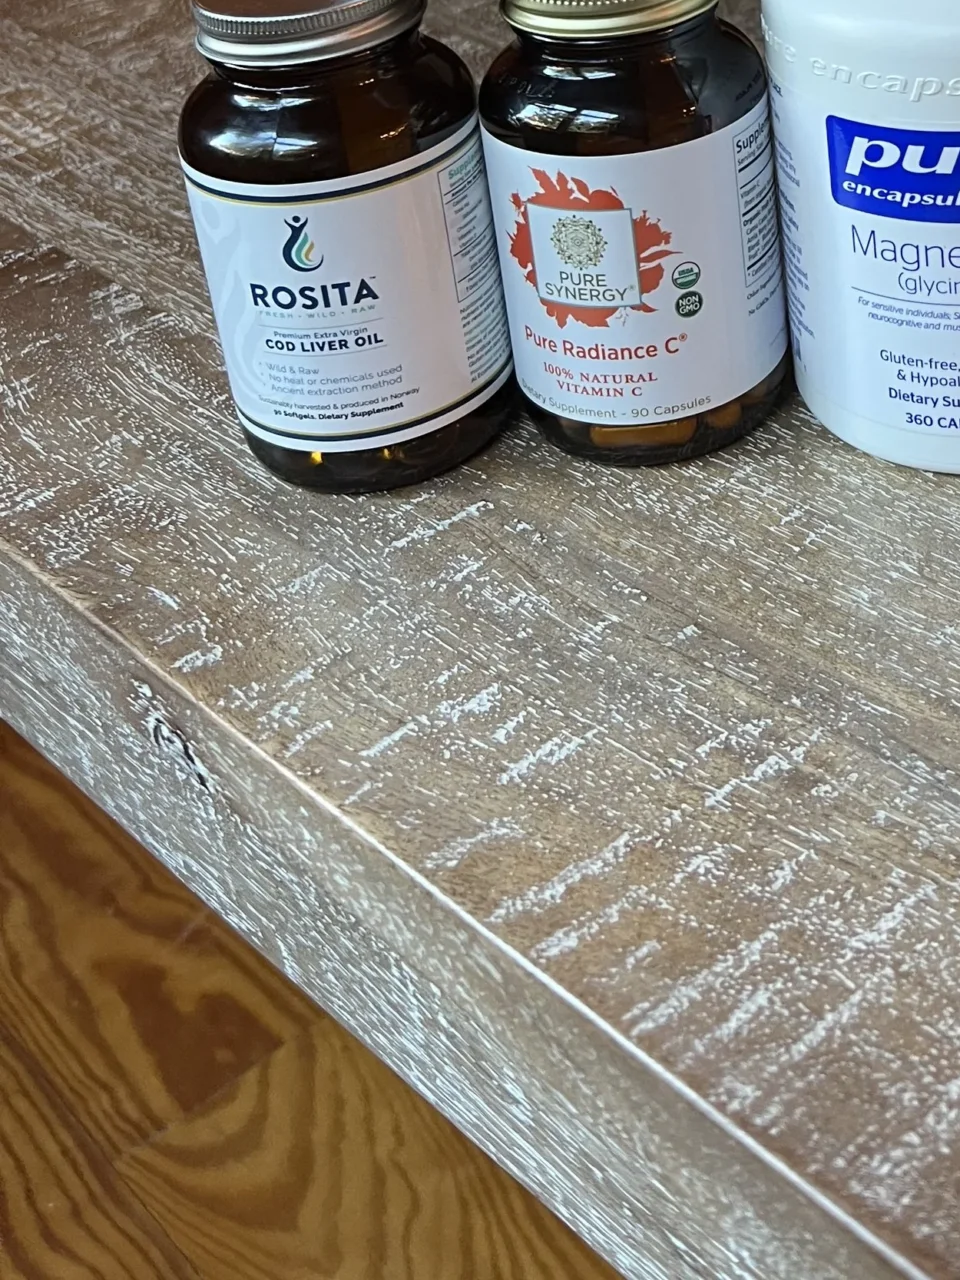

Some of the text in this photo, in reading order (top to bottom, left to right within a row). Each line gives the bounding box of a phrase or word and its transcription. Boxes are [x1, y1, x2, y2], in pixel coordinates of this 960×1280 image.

[559, 271, 607, 287] PURE
[249, 278, 380, 310] ROSITA
[679, 294, 699, 307] NON
[258, 304, 376, 319] FRESH WILD RAW
[679, 302, 700, 314] GMO
[857, 296, 870, 306] For
[871, 301, 904, 315] sensitive
[867, 311, 922, 329] neurocognitive
[923, 321, 941, 331] and
[265, 332, 384, 352] COD LIVER OIL
[273, 326, 368, 340] Premium Extra Virgin
[524, 324, 558, 353] Pure
[562, 339, 659, 361] Radiance
[265, 362, 320, 375] Wild & Raw
[268, 364, 403, 386] No heat or chemicals used
[543, 361, 659, 385] 100% NATURAL
[896, 368, 907, 381] &
[271, 376, 403, 396] Ancient extraction method
[556, 379, 643, 398] VITAMIN C
[293, 387, 421, 411] harvested produced in Norway
[521, 377, 712, 419] Dietary Supplement 90 Capsules
[888, 386, 939, 409] Dietary
[318, 401, 404, 421] Dietary Supplement
[905, 412, 934, 427] 360
